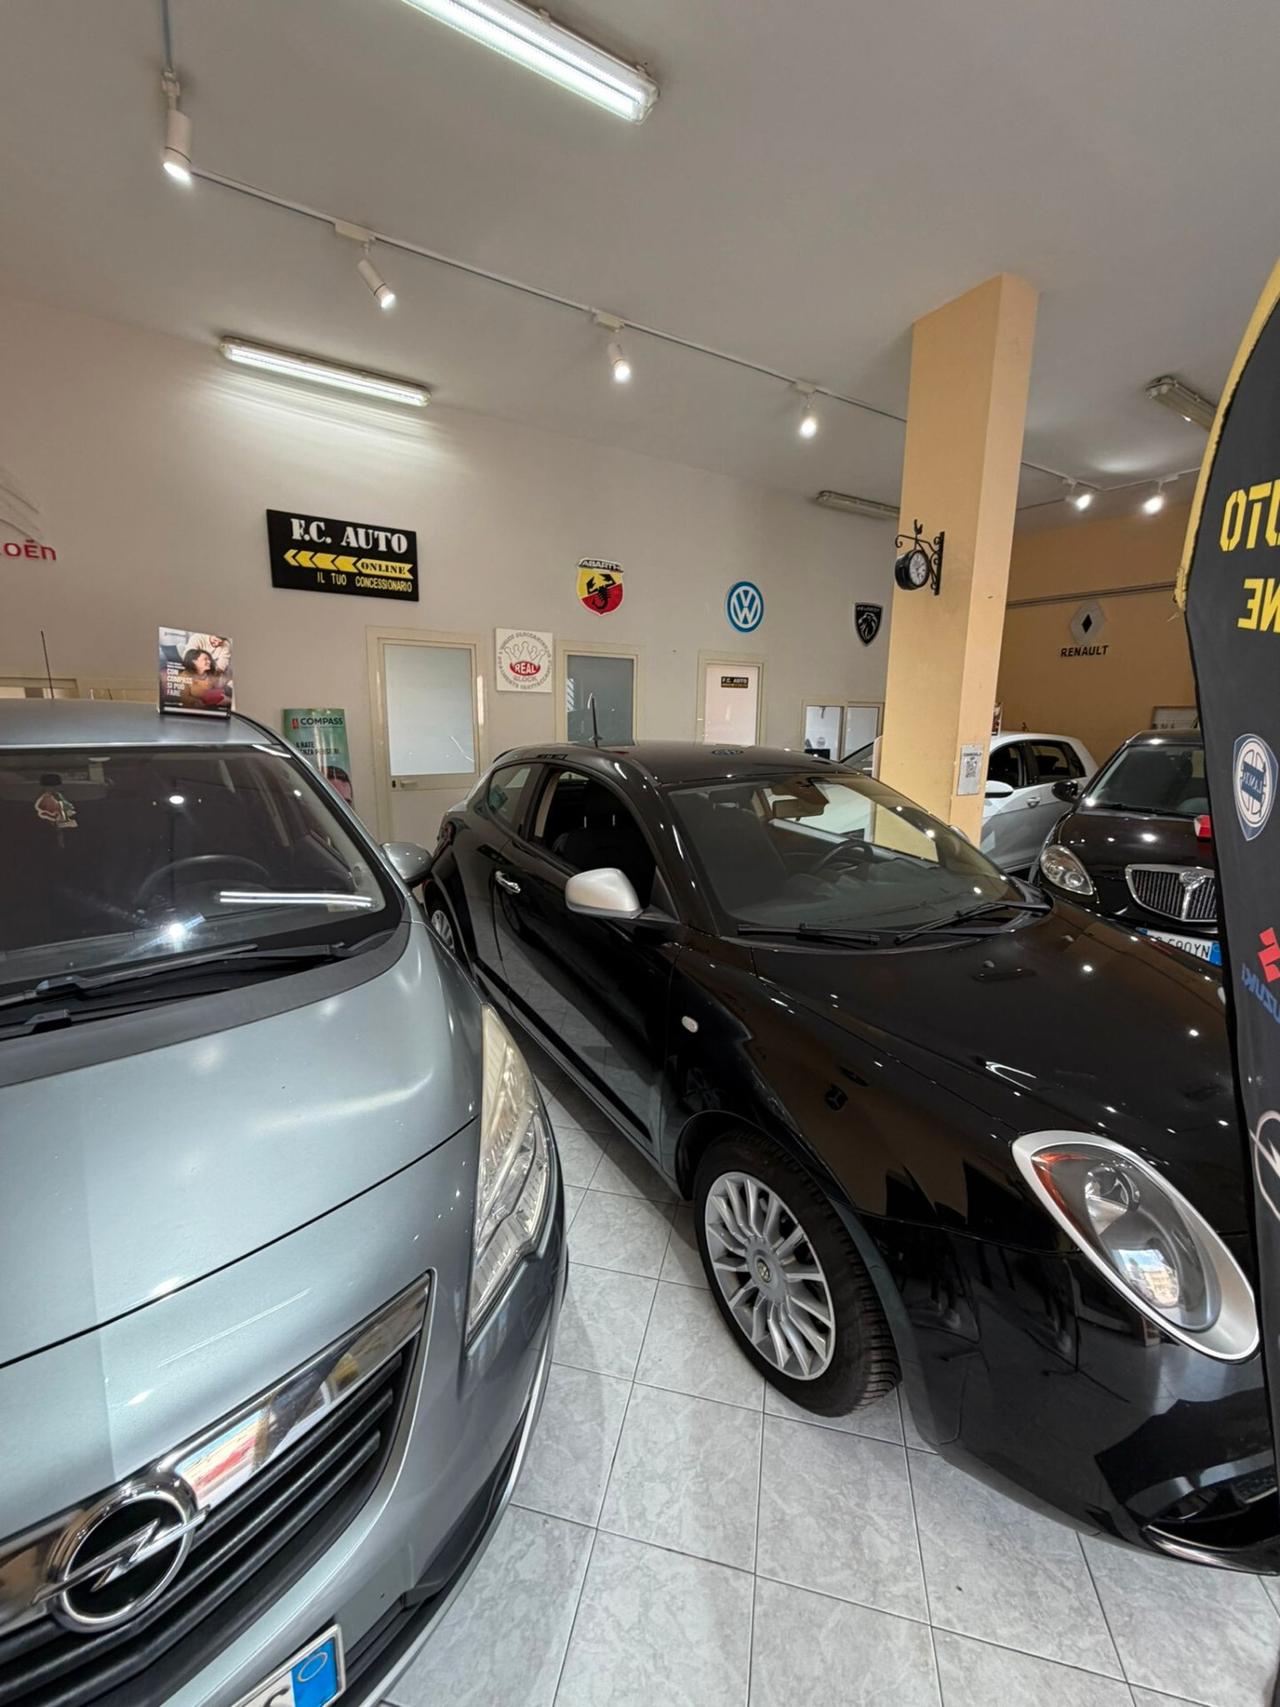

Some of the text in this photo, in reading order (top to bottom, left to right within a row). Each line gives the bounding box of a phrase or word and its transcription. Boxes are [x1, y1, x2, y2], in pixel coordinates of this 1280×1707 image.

[290, 518, 408, 554] F.C. AUTO
[361, 562, 406, 575] ONLINE
[317, 571, 412, 592] IL TUO CONCESSIONARIO
[1060, 644, 1109, 658] RENAULT
[514, 662, 537, 674] REAL
[300, 717, 344, 725] COMPASS
